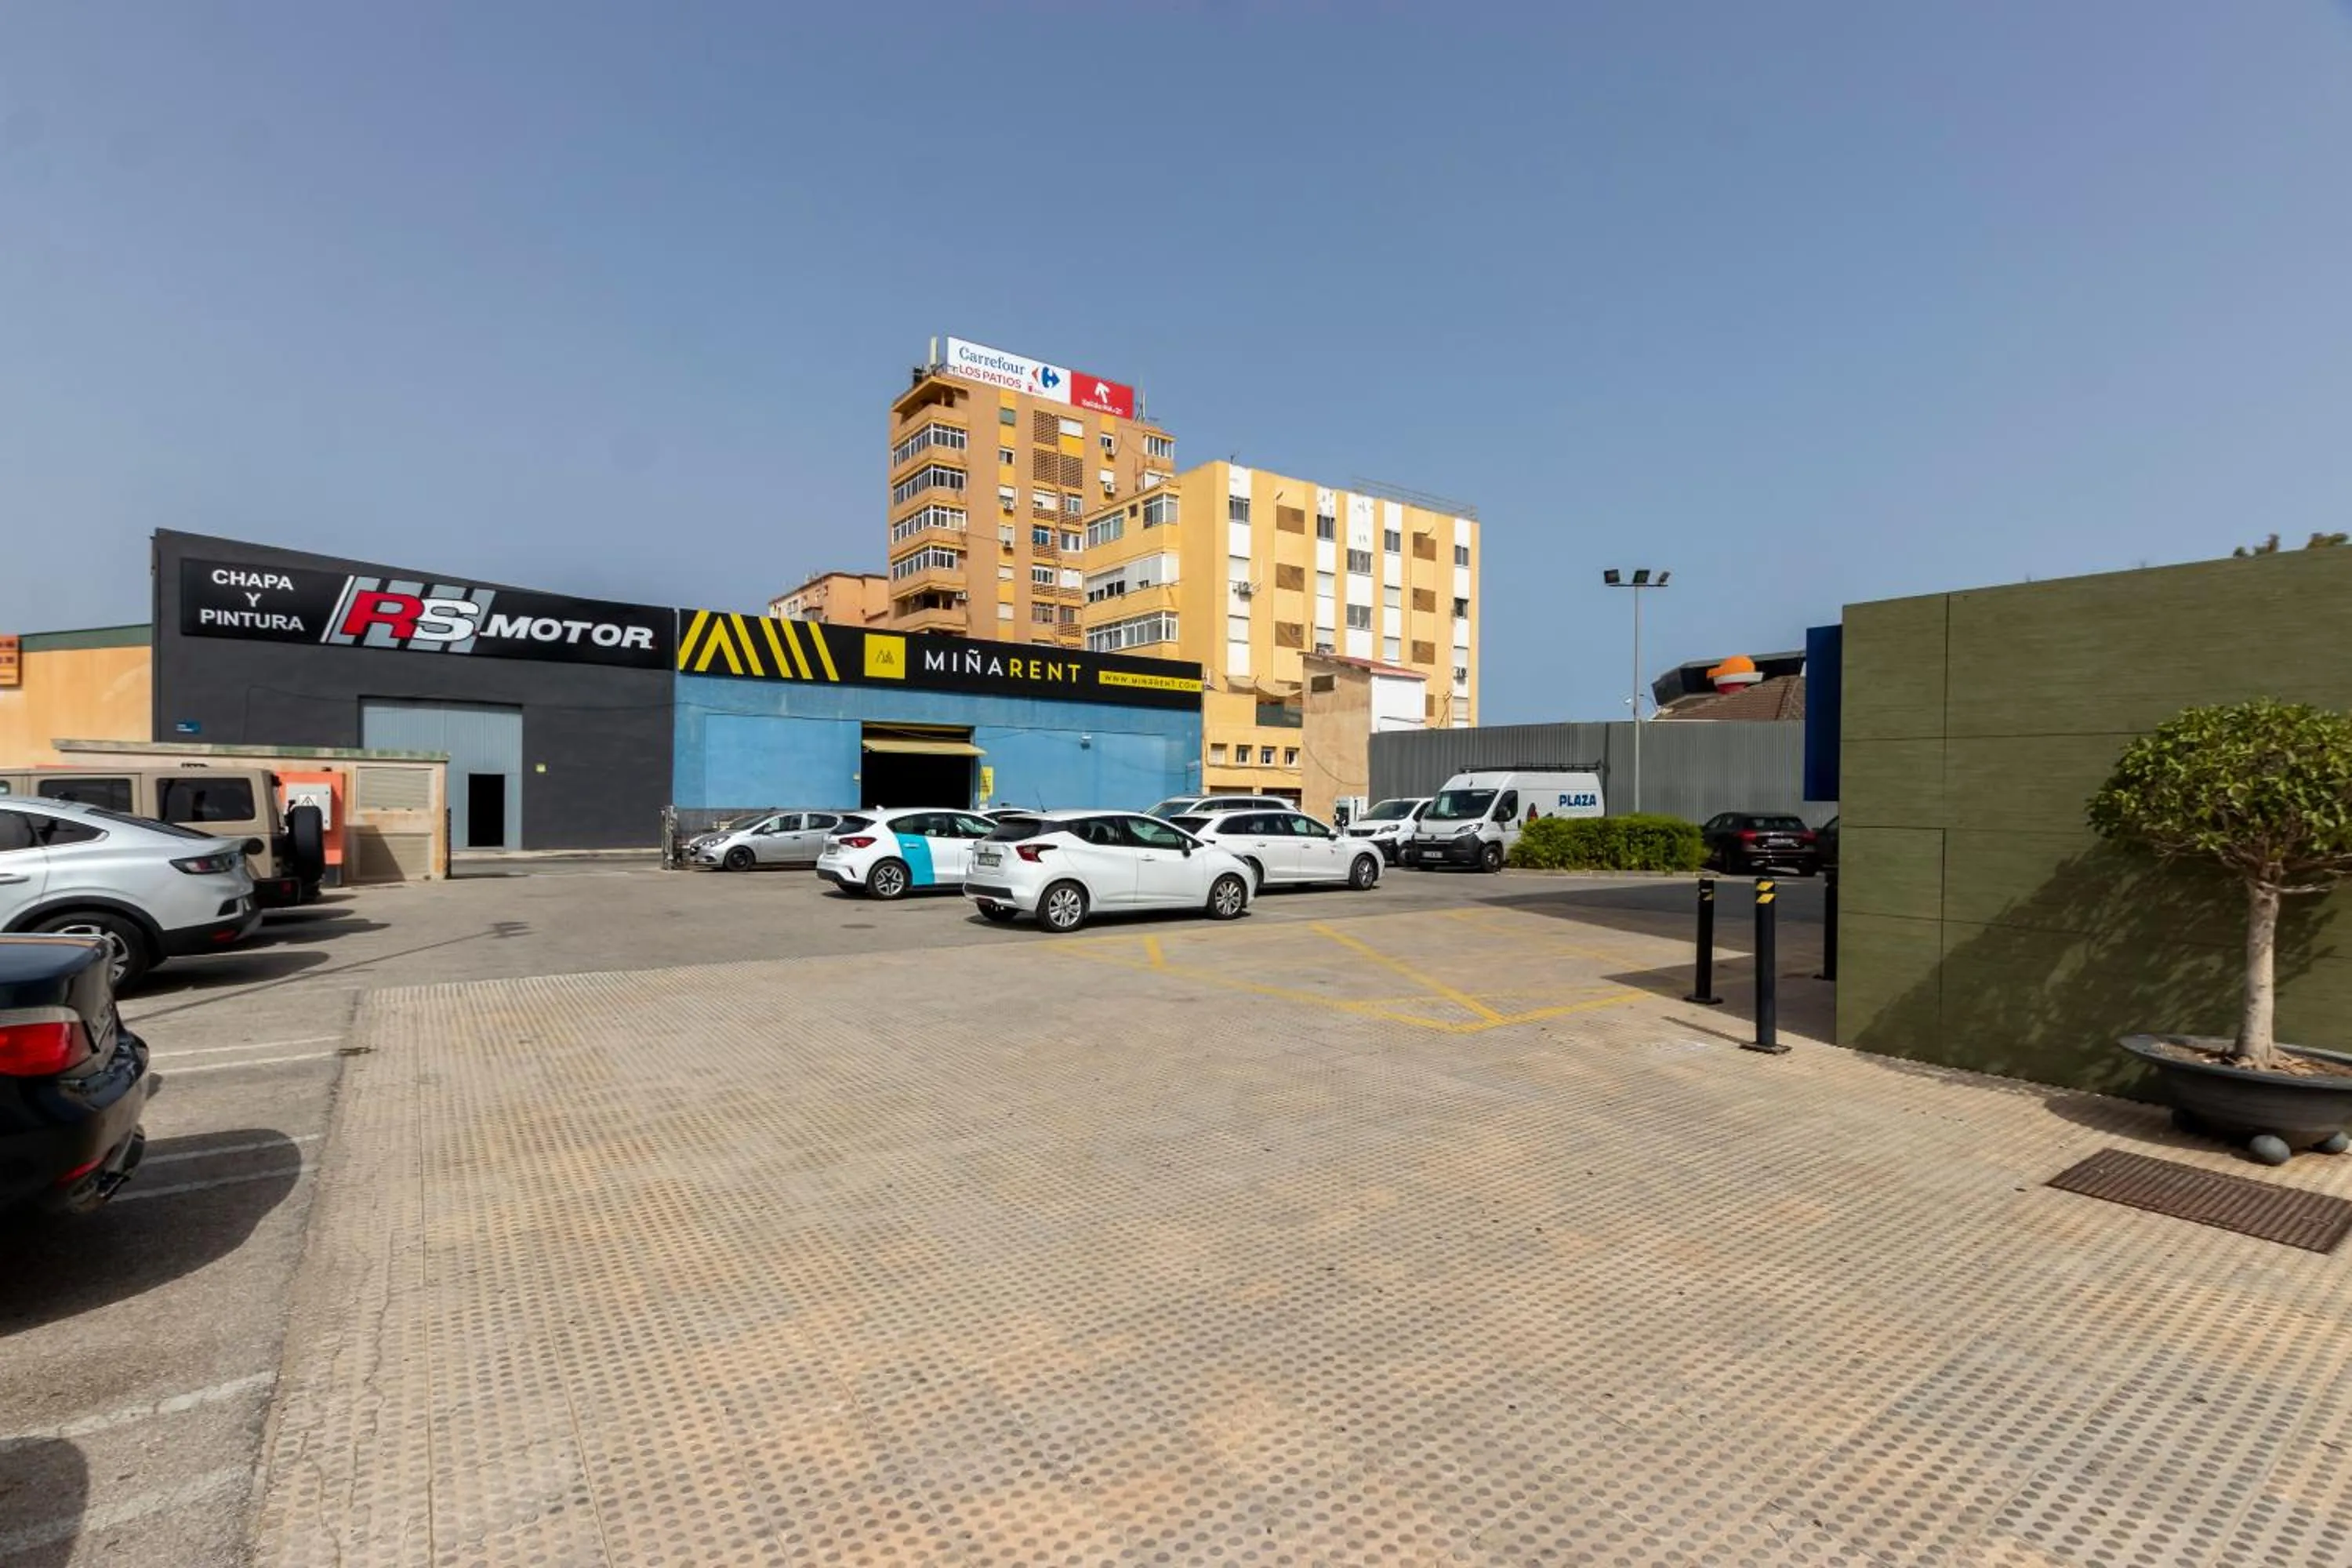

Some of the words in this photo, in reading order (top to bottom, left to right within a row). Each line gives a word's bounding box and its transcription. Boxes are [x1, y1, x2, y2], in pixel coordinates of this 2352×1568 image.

[959, 346, 1026, 376] Carrefour
[959, 364, 982, 379] LOS
[982, 371, 1022, 389] PATIOS
[212, 569, 294, 591] CHAPA
[245, 592, 262, 608] Y
[200, 608, 305, 632] PINTURA
[340, 590, 481, 642] RS
[480, 614, 655, 650] MOTOR
[1559, 794, 1596, 807] PLAZA
